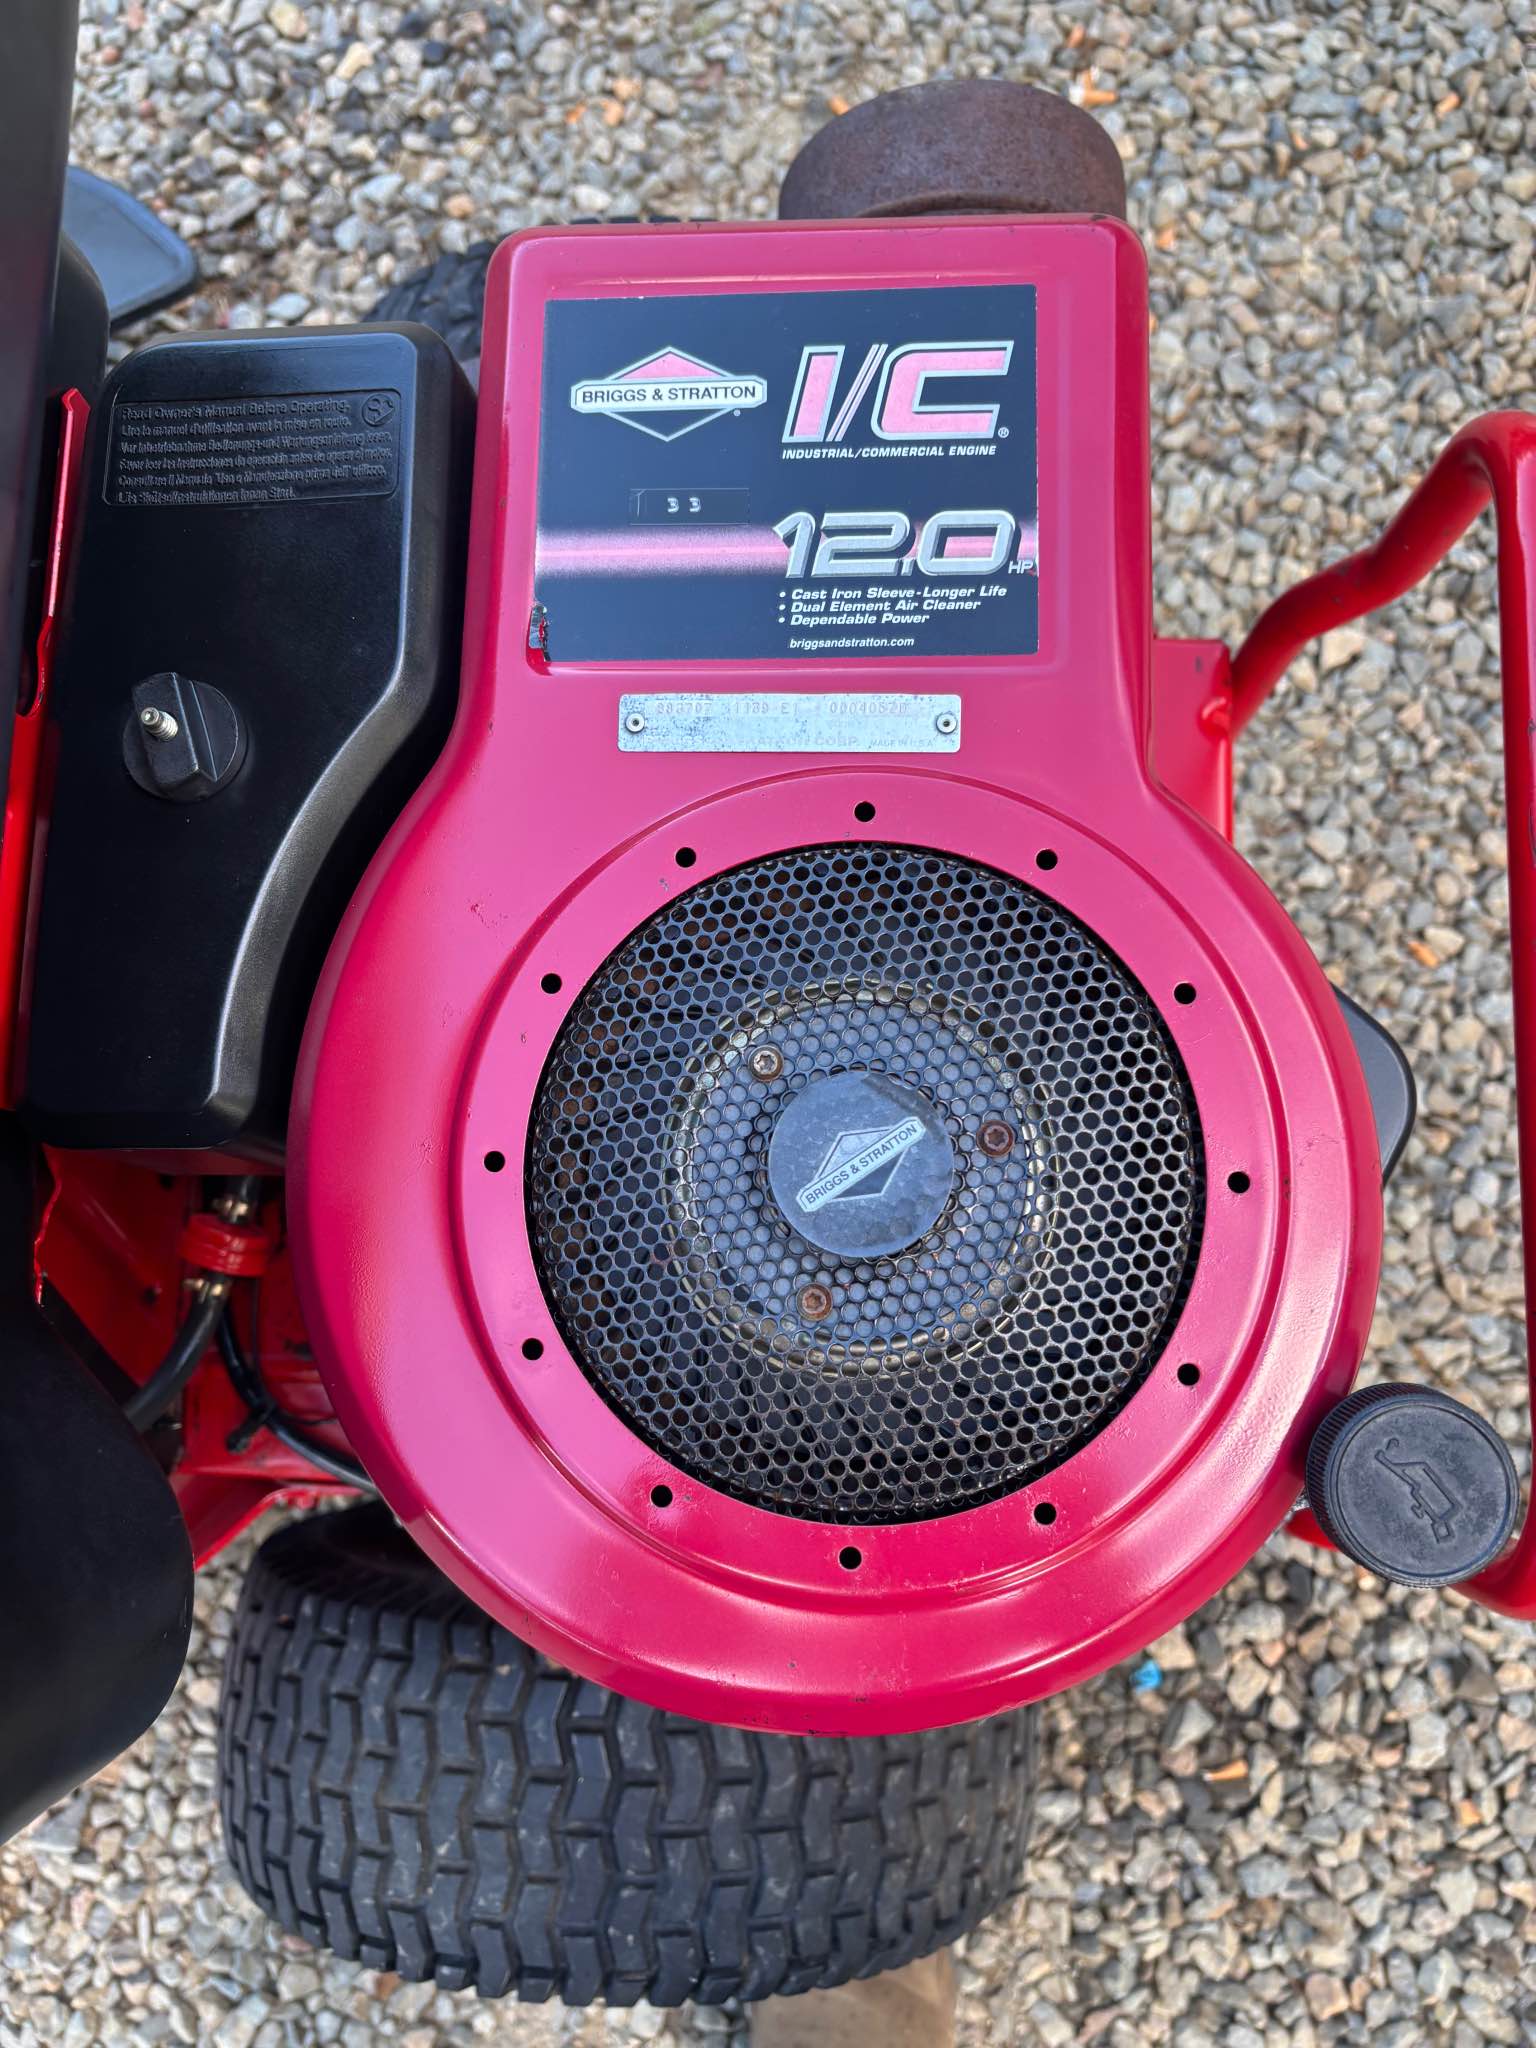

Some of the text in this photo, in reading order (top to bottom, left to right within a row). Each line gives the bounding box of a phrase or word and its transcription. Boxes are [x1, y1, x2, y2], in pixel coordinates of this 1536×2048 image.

[581, 384, 757, 404] BRIGGS & STRATTON
[781, 444, 997, 459] INDUSTRIAL/COMMERCIAL ENGINE
[1008, 561, 1034, 575] HP
[791, 588, 828, 600] Cast
[831, 587, 861, 599] Iron
[980, 585, 1008, 598] Life
[790, 599, 982, 614] Dual Element Air Cleaner
[790, 612, 931, 628] Dependable Power
[789, 637, 915, 651] briggsandstratton.com
[805, 1123, 918, 1205] BRIGGS & STRATTON
